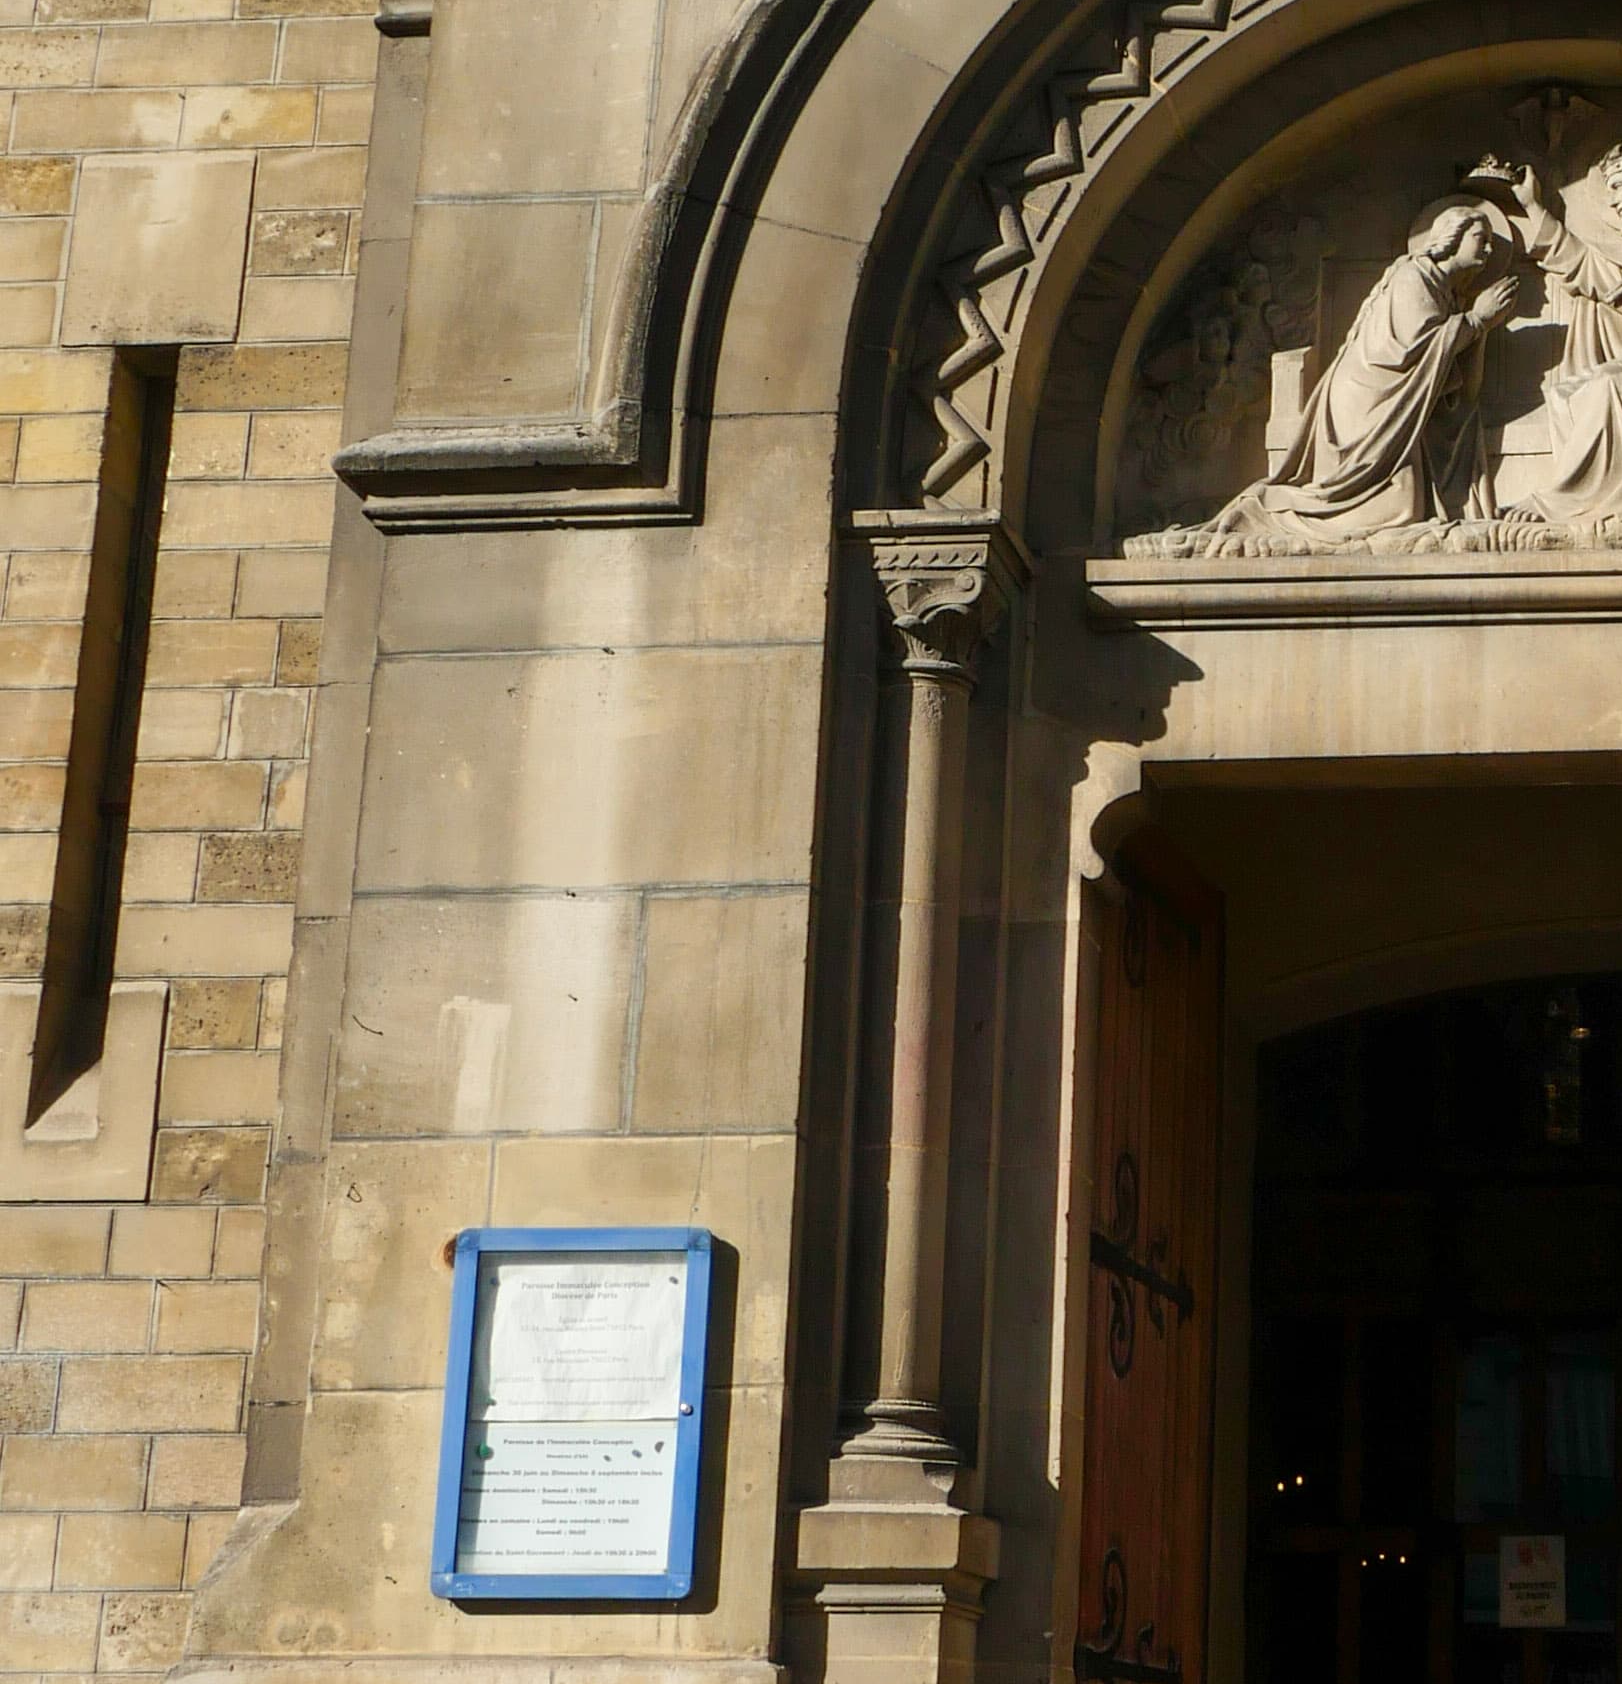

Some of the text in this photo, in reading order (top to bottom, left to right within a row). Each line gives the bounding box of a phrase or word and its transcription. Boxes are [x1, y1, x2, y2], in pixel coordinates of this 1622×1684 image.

[557, 1281, 602, 1289] Immaculée
[604, 1281, 650, 1289] Conception
[597, 1291, 618, 1299] Paris
